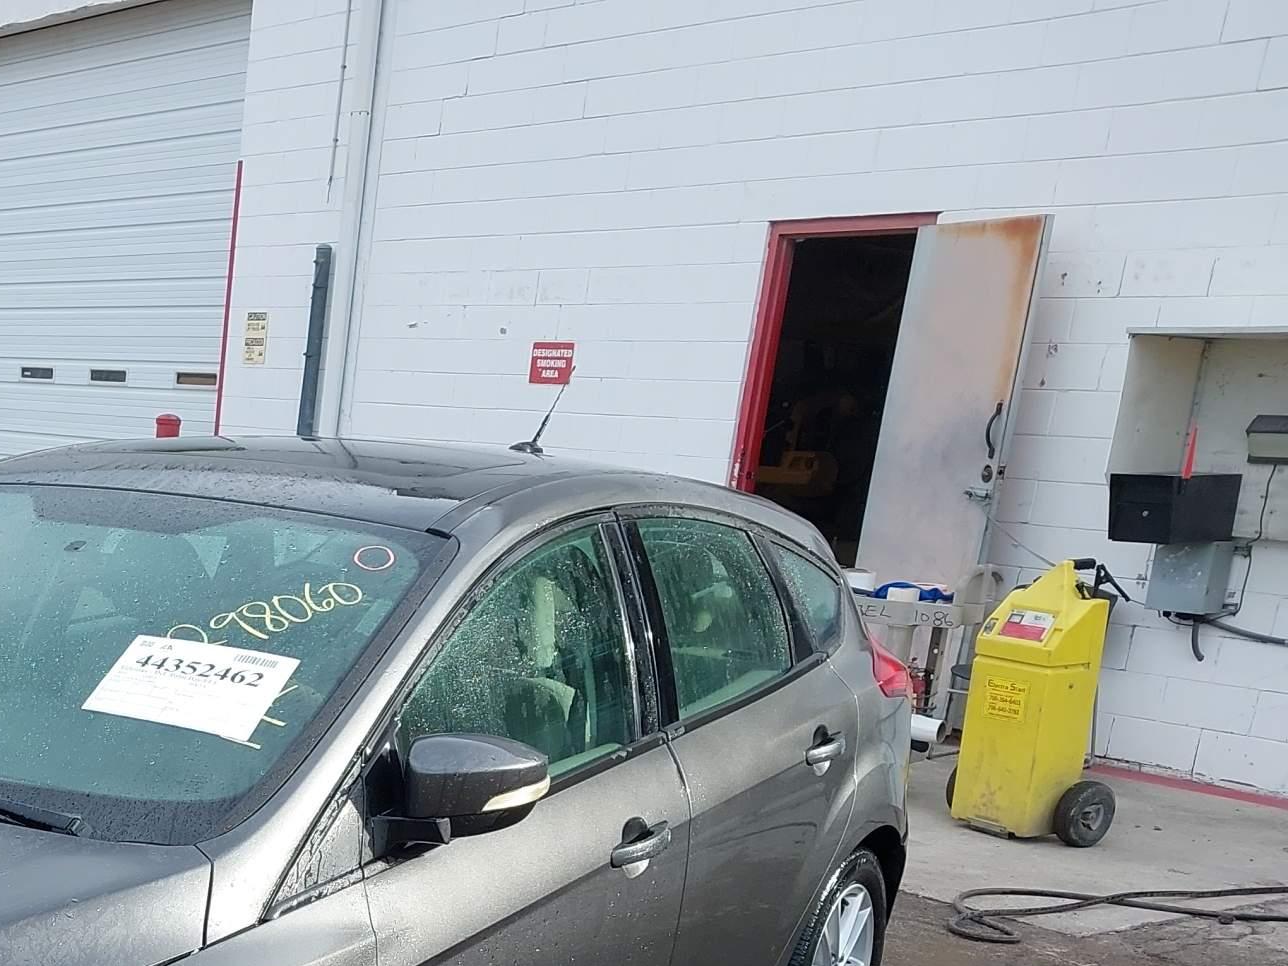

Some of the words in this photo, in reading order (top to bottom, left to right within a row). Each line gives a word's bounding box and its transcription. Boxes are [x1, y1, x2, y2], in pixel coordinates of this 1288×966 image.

[533, 348, 573, 358] DESIGNATED
[536, 358, 567, 368] SMOKING
[541, 369, 559, 378] AREA
[135, 654, 265, 688] 44352462
